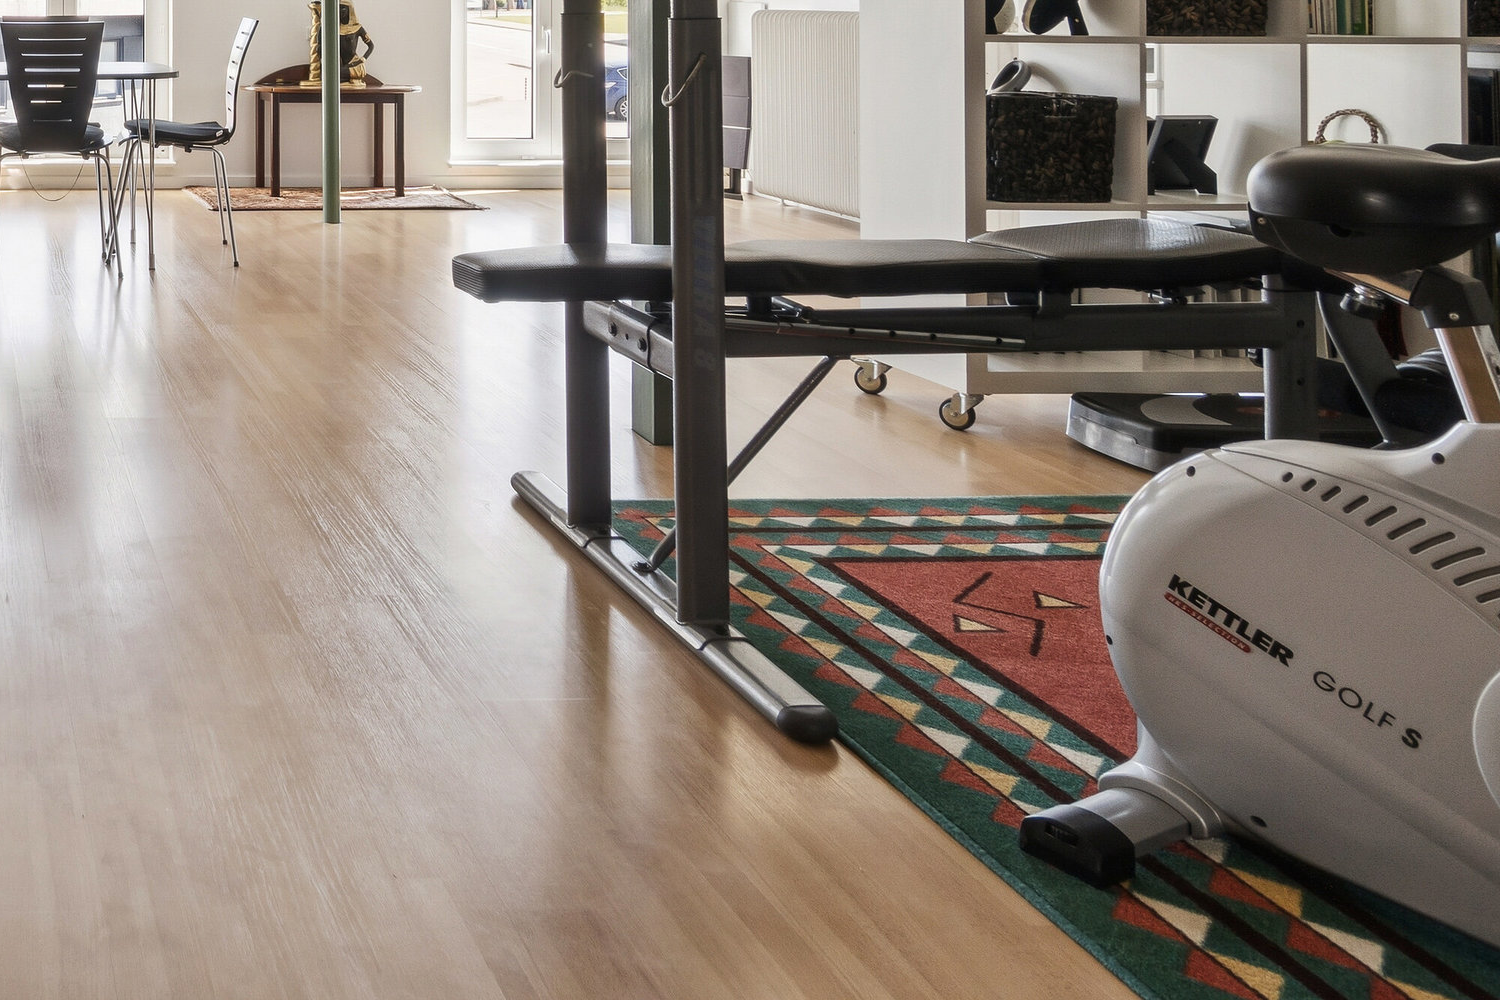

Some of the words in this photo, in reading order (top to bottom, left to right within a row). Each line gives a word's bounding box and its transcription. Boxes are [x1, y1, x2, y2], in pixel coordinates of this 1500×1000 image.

[1168, 573, 1294, 668] KETTLER
[1313, 670, 1396, 727] GOLF
[1401, 727, 1422, 749] S
